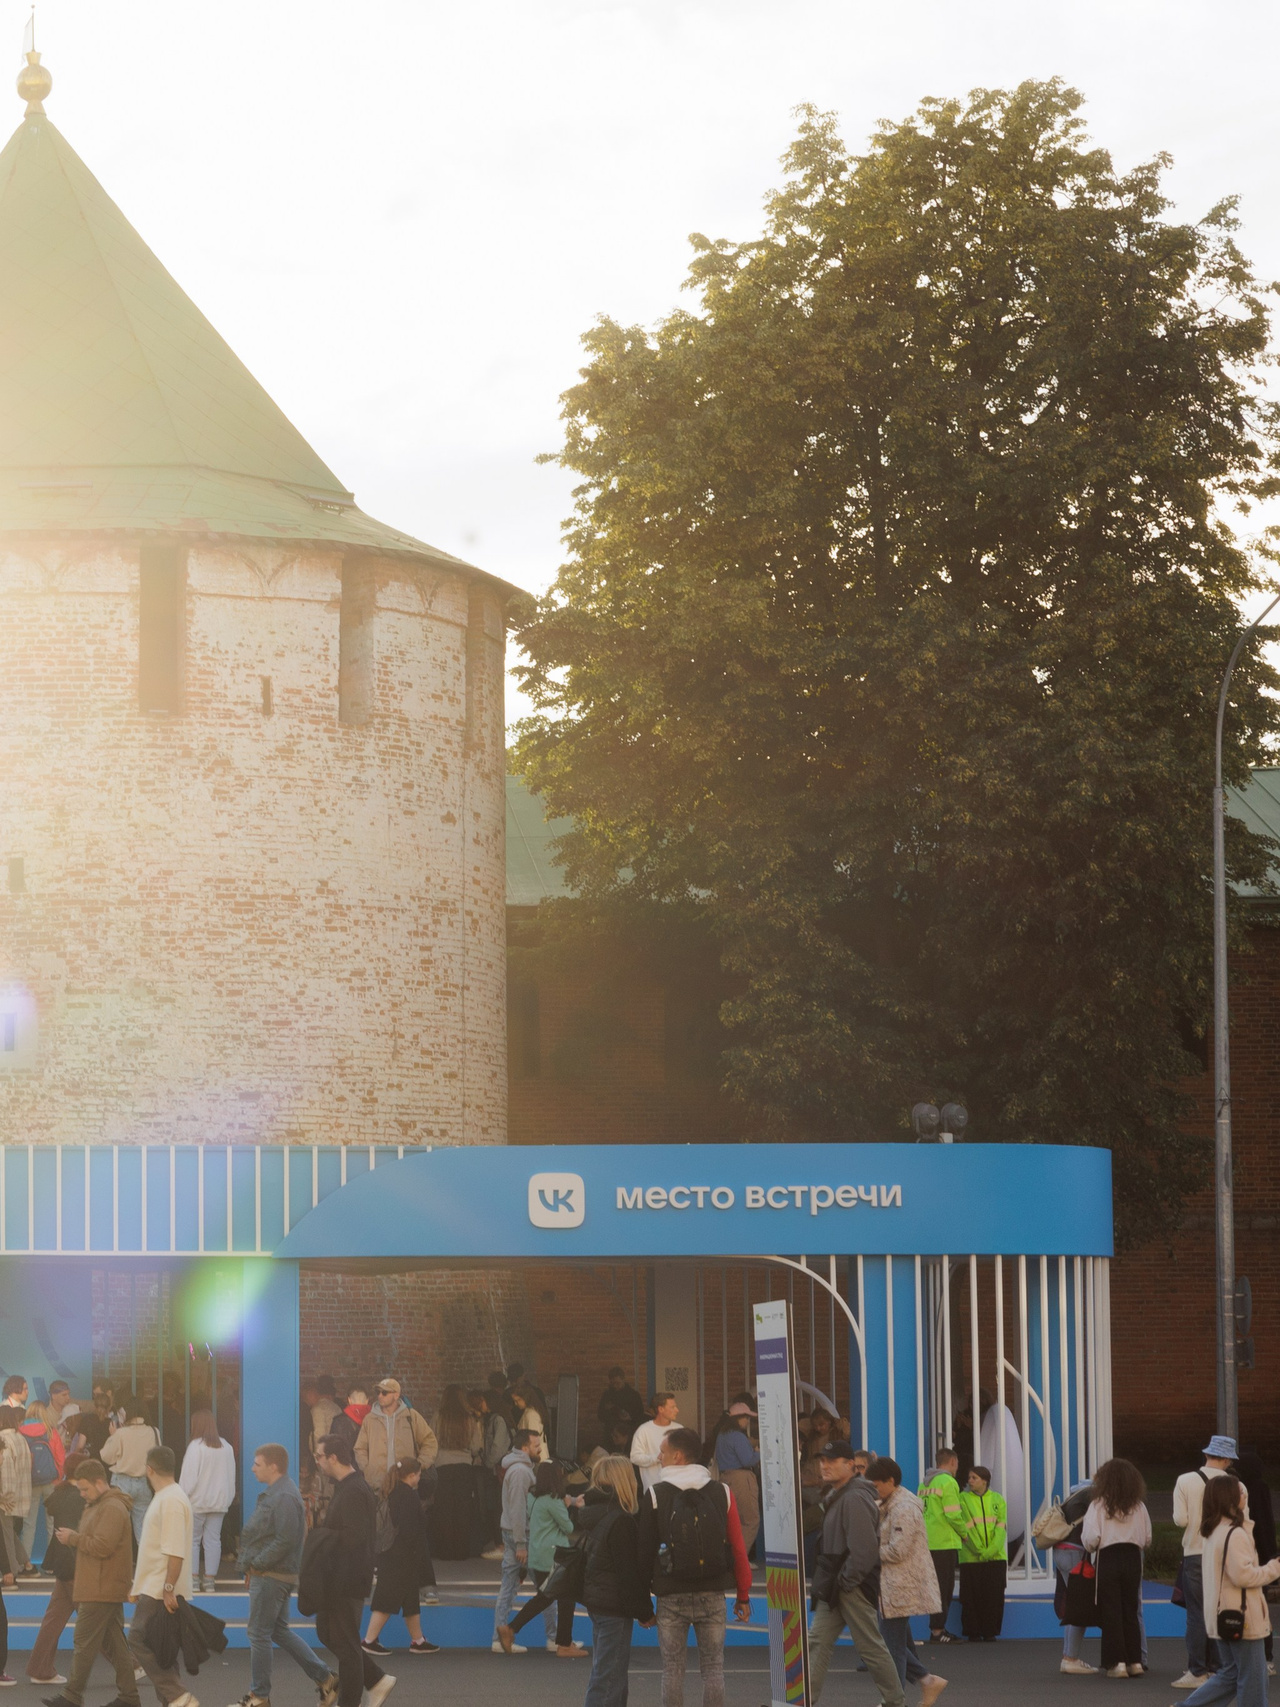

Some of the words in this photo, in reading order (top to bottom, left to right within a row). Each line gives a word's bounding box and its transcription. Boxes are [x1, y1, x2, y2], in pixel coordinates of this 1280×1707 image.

[538, 1189, 574, 1213] VK
[616, 1186, 735, 1210] место
[745, 1184, 902, 1215] встречи
